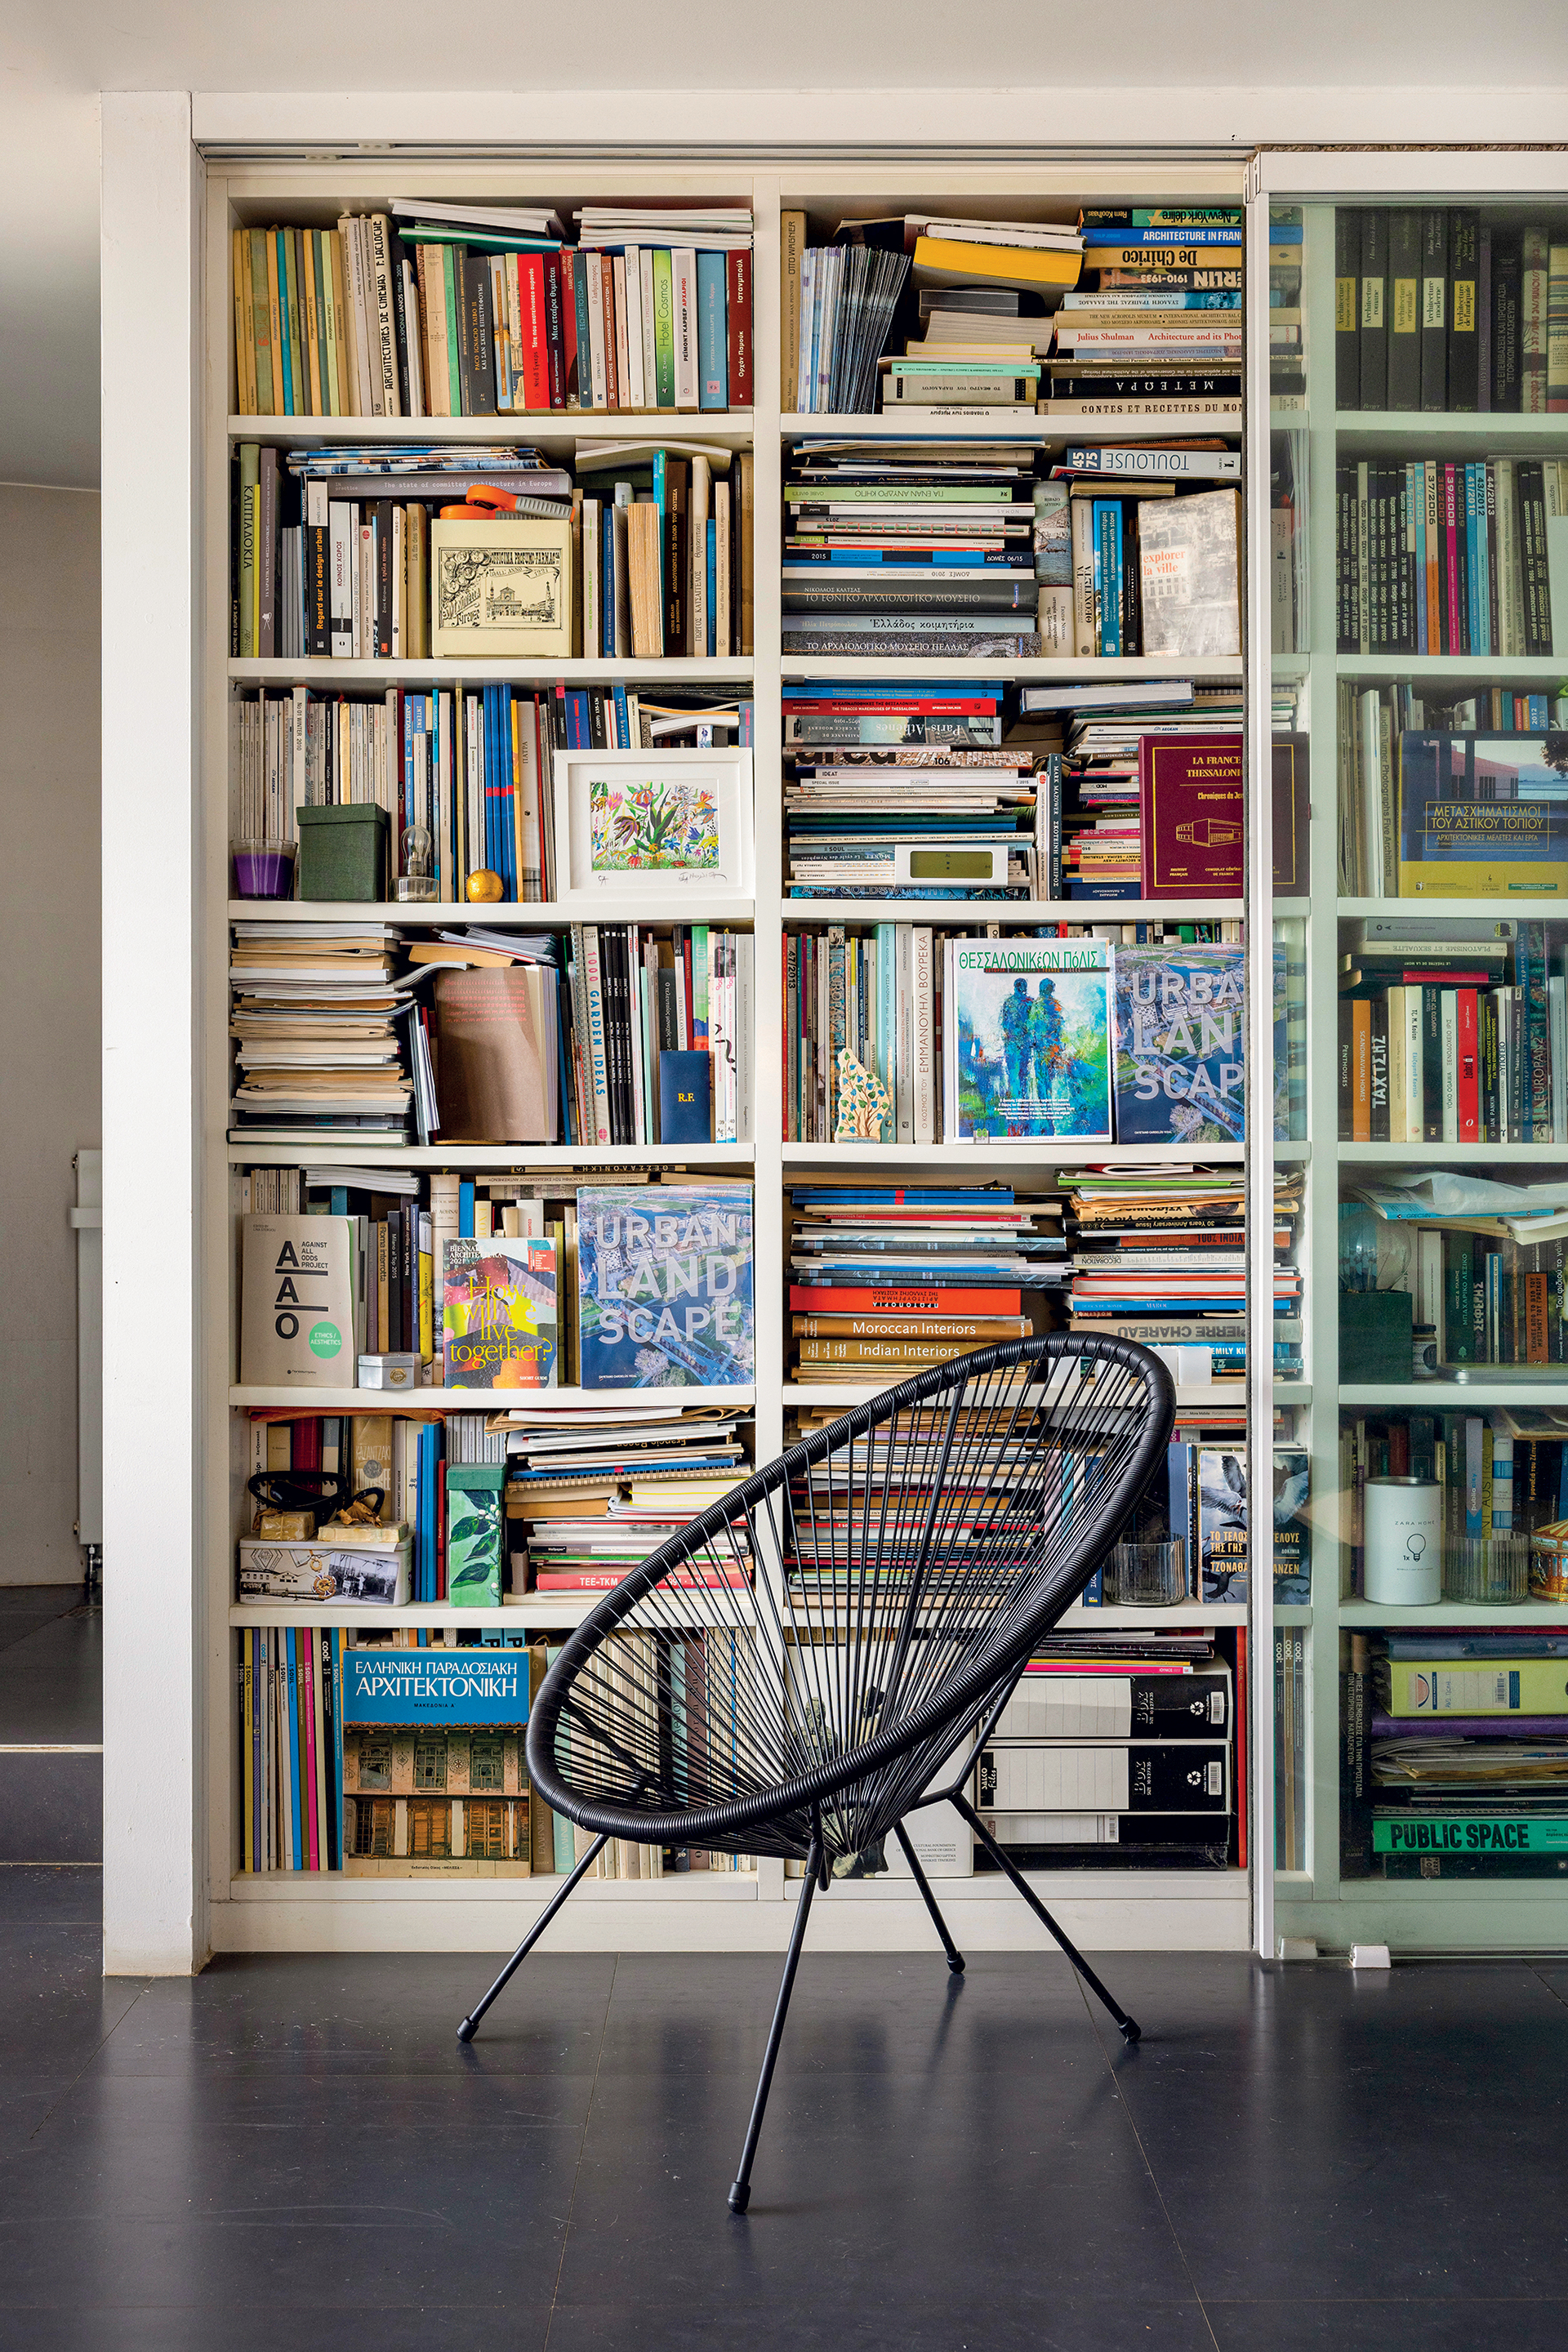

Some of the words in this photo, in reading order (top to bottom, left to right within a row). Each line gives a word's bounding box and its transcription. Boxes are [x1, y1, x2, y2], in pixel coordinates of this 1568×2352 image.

[374, 220, 384, 259] LACLOCHE
[787, 221, 795, 255] WAGNER
[1143, 231, 1205, 242] ARCHITECTURE
[1207, 232, 1217, 242] IN
[1122, 250, 1175, 266] Chirico
[1179, 251, 1197, 266] De
[549, 267, 558, 297] θυμάται
[737, 260, 745, 304] Ιστανμπούλ
[1141, 274, 1187, 283] 1910-1933
[657, 279, 669, 318] Cosmos
[381, 312, 387, 322] DE
[550, 299, 558, 323] εταίρα
[657, 322, 670, 346] Hotel
[737, 332, 745, 354] Παμούκ
[1078, 333, 1099, 341] Julius
[1101, 333, 1134, 341] Shulman
[381, 327, 394, 389] ARCHITECTURES
[737, 358, 746, 377] Ορχάν
[1117, 381, 1214, 390] ΜΕΤΕΩΡΑ
[1073, 452, 1084, 468] 45
[1086, 452, 1098, 468] 75
[1106, 452, 1189, 470] TOULOUSE
[243, 485, 252, 569] ΚΑΠΠΑΔΟΚΙΑ
[315, 528, 323, 552] urbain
[315, 554, 325, 578] design
[1143, 550, 1186, 564] explorer
[1143, 565, 1153, 576] la
[1156, 564, 1178, 575] ville
[805, 595, 818, 603] ΤΟ
[822, 595, 859, 603] ΕΘΝΙΚΟ
[860, 594, 933, 603] ΑΡΧΑΙΟΛΟΓΙΚΟ
[936, 595, 980, 603] ΜΟΥΣΕΙΟ
[316, 603, 325, 629] Regard
[920, 619, 974, 630] κοιμητήρια
[875, 724, 962, 737] Paris-Athènes
[934, 757, 951, 765] 106
[1192, 756, 1204, 764] LA
[1207, 756, 1241, 764] FRANCE
[1434, 806, 1540, 817] ΜΕΤΑΣΧΗΜΑΤΙΣΜΟΙ
[1431, 818, 1452, 830] ΤΟΥ
[1455, 818, 1499, 830] ΑΣΤΙΚΟΥ
[1503, 818, 1544, 830] ΤΟΠΙΟΥ
[587, 951, 599, 982] 1000
[919, 935, 928, 988] ΒΟΥΡΕΚΑ
[1133, 973, 1243, 1004] URBA
[590, 990, 602, 1045] GARDEN
[919, 992, 929, 1073] ΕΜΜΑΝΟΥΗΛ
[595, 1054, 605, 1095] IDEAS
[1134, 1063, 1244, 1099] SCAP
[1372, 1036, 1387, 1109] ΤΑΧΤΣΗΣ
[1534, 1045, 1545, 1101] EUROPAN
[678, 1093, 694, 1102] R.F.
[597, 1215, 737, 1250] URBAN
[276, 1241, 299, 1267] A
[469, 1276, 526, 1301] How
[599, 1256, 737, 1300] LAND
[276, 1276, 299, 1303] A
[460, 1294, 498, 1321] will
[506, 1306, 537, 1321] we
[1473, 1282, 1484, 1331] ΣΕΦΕΡΗΣ
[275, 1312, 299, 1339] O
[480, 1323, 518, 1341] live
[598, 1307, 739, 1344] SCAPE
[853, 1321, 917, 1334] Moroccan
[921, 1323, 977, 1334] Interiors
[1118, 1325, 1192, 1338] CHAREAU
[450, 1338, 553, 1369] together?
[859, 1344, 900, 1356] Indian
[904, 1344, 960, 1357] Interiors
[356, 1446, 390, 1459] KAZANTZAKI
[1210, 1530, 1220, 1541] ΤΟ
[1210, 1542, 1225, 1552] ΤΗΣ
[1228, 1542, 1243, 1552] ΓΗΣ
[580, 1577, 617, 1586] TEE-TKM
[356, 1662, 421, 1675] ΕΛΛΗΝΙΚΗ
[426, 1662, 517, 1675] ΠΑΡΑΔΟΣΙΑΚΗ
[356, 1677, 517, 1697] ΑΡΧΙΤΕΚΤΟΝΙΚΗ
[988, 1767, 997, 1788] Files
[1391, 1824, 1463, 1849] PUBLIC
[1465, 1824, 1530, 1849] SPACE
